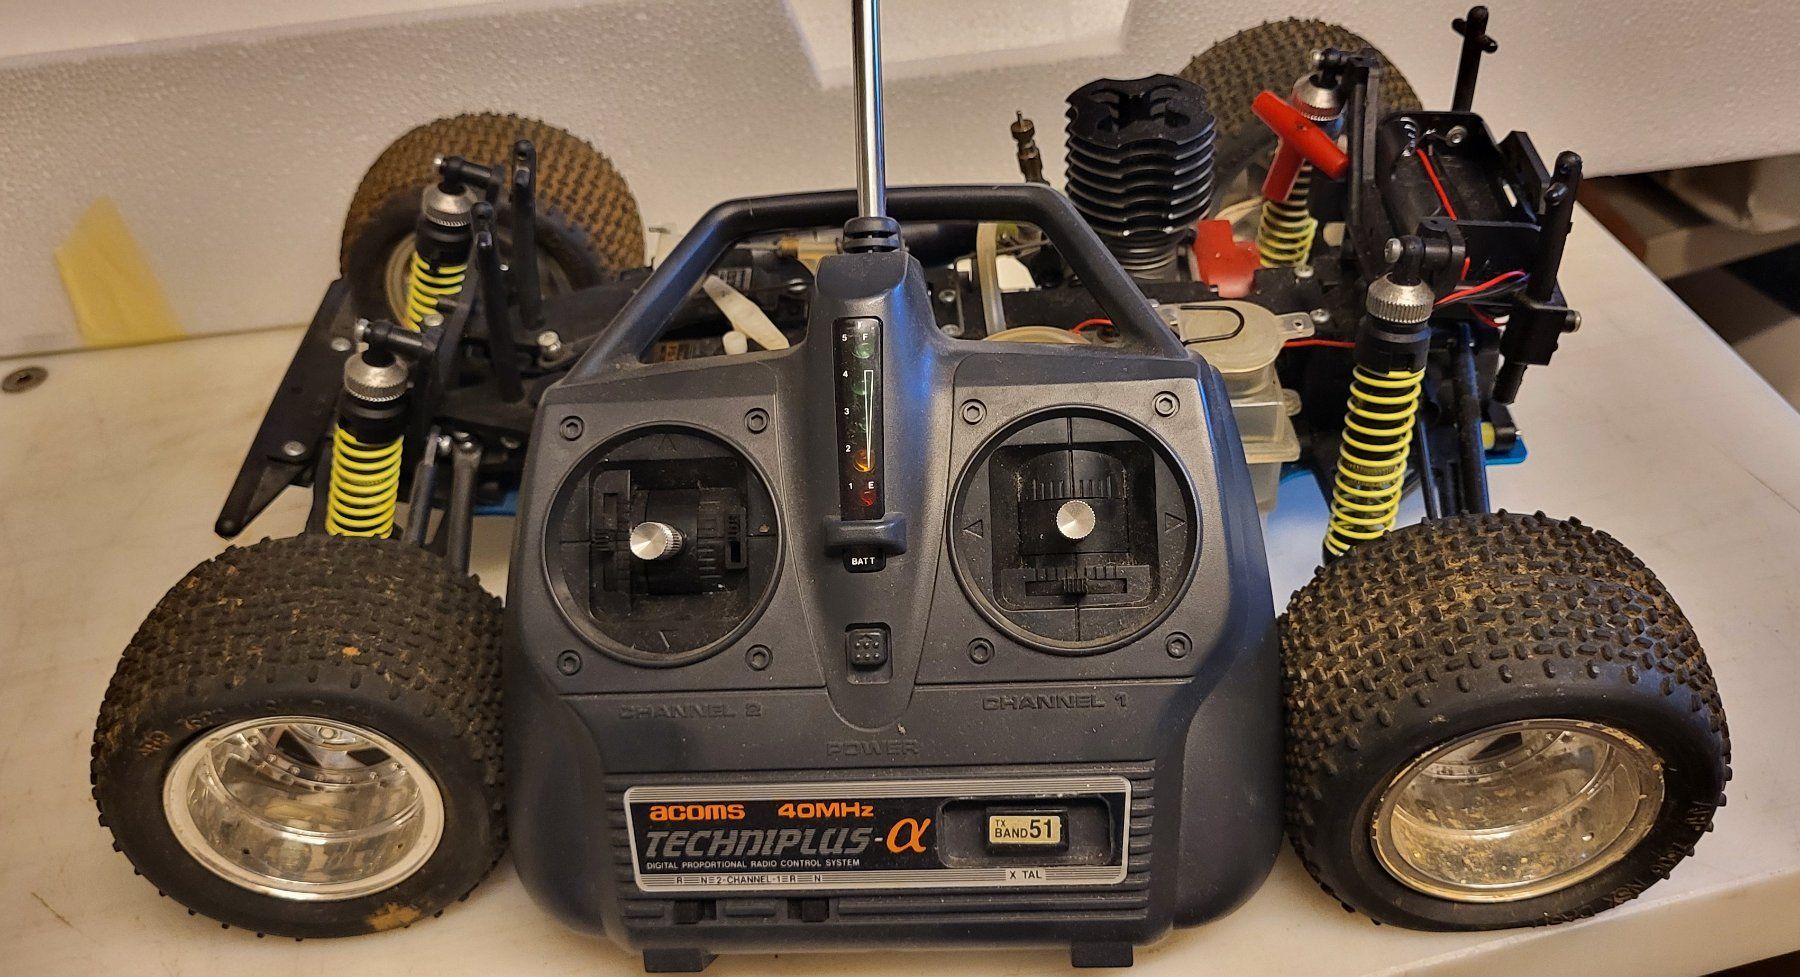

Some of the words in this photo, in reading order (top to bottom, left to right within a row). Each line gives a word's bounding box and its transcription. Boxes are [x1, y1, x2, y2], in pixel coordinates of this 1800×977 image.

[842, 333, 848, 342] 5
[862, 333, 869, 341] F
[842, 370, 849, 378] 4
[843, 407, 850, 416] 3
[845, 444, 851, 453] 2
[867, 481, 875, 490] E
[851, 556, 875, 566] BATT
[981, 692, 1106, 711] CHANNEL
[1114, 692, 1128, 708] 1
[618, 703, 736, 720] CHANNEL
[745, 701, 762, 718] 2
[826, 739, 920, 758] POWER
[649, 803, 746, 821] acoms
[777, 802, 875, 819] 40MHz
[994, 828, 1028, 838] BAND
[1029, 819, 1053, 838] 51
[995, 819, 1006, 828] TX
[647, 861, 679, 870] DIGITAL
[682, 860, 747, 869] PROPORTIONAL
[751, 860, 778, 868] RADIO
[781, 859, 822, 867] CONTROL
[826, 858, 860, 867] SYSTEM
[676, 876, 684, 884] R
[814, 874, 822, 882] N
